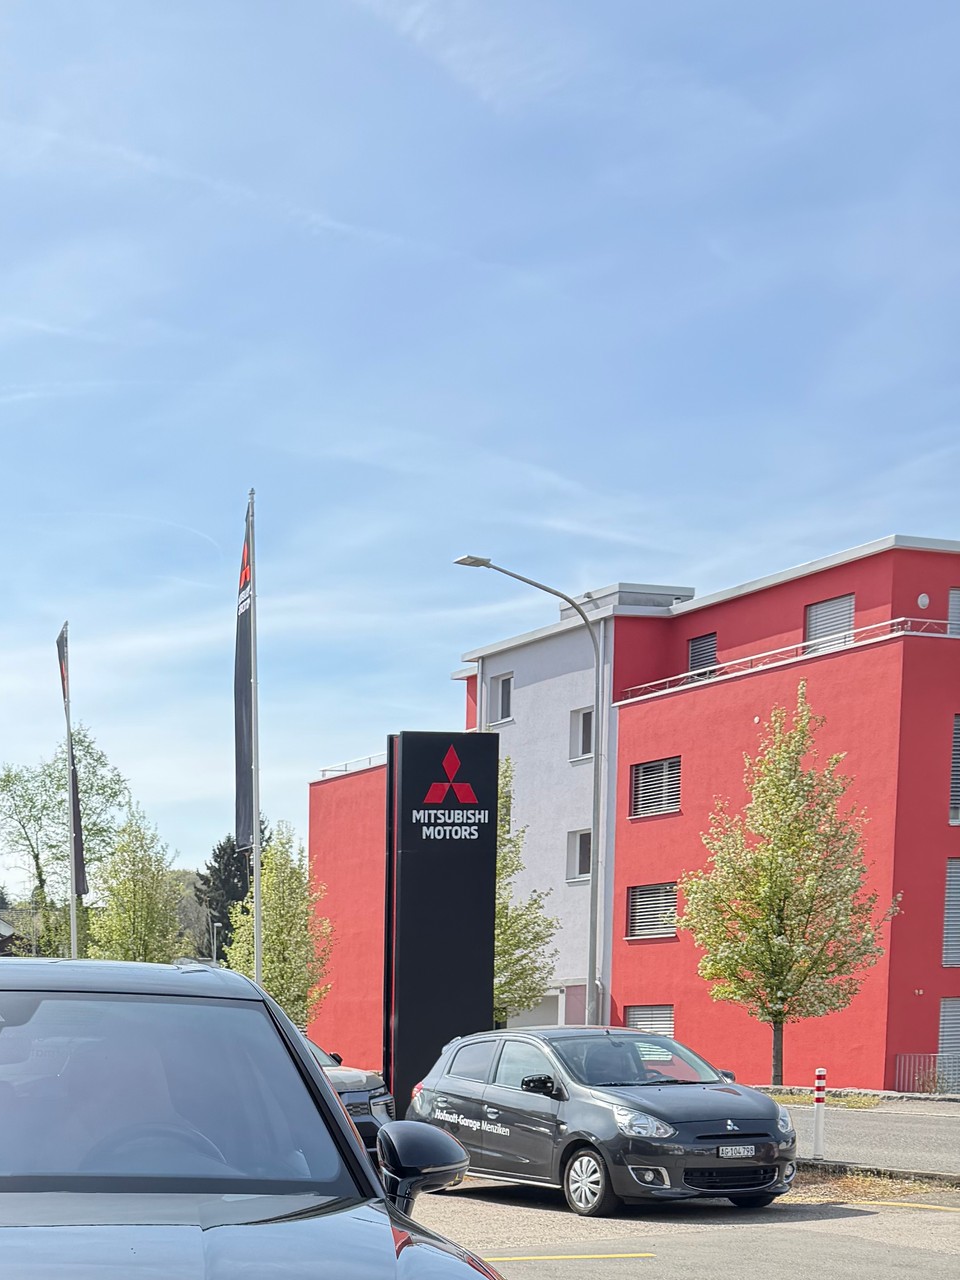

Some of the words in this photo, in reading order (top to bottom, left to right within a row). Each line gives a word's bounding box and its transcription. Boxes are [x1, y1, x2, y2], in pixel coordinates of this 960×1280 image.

[412, 809, 489, 823] MITSUBISHI
[422, 826, 479, 839] MOTORS
[481, 1120, 510, 1136] Menziken
